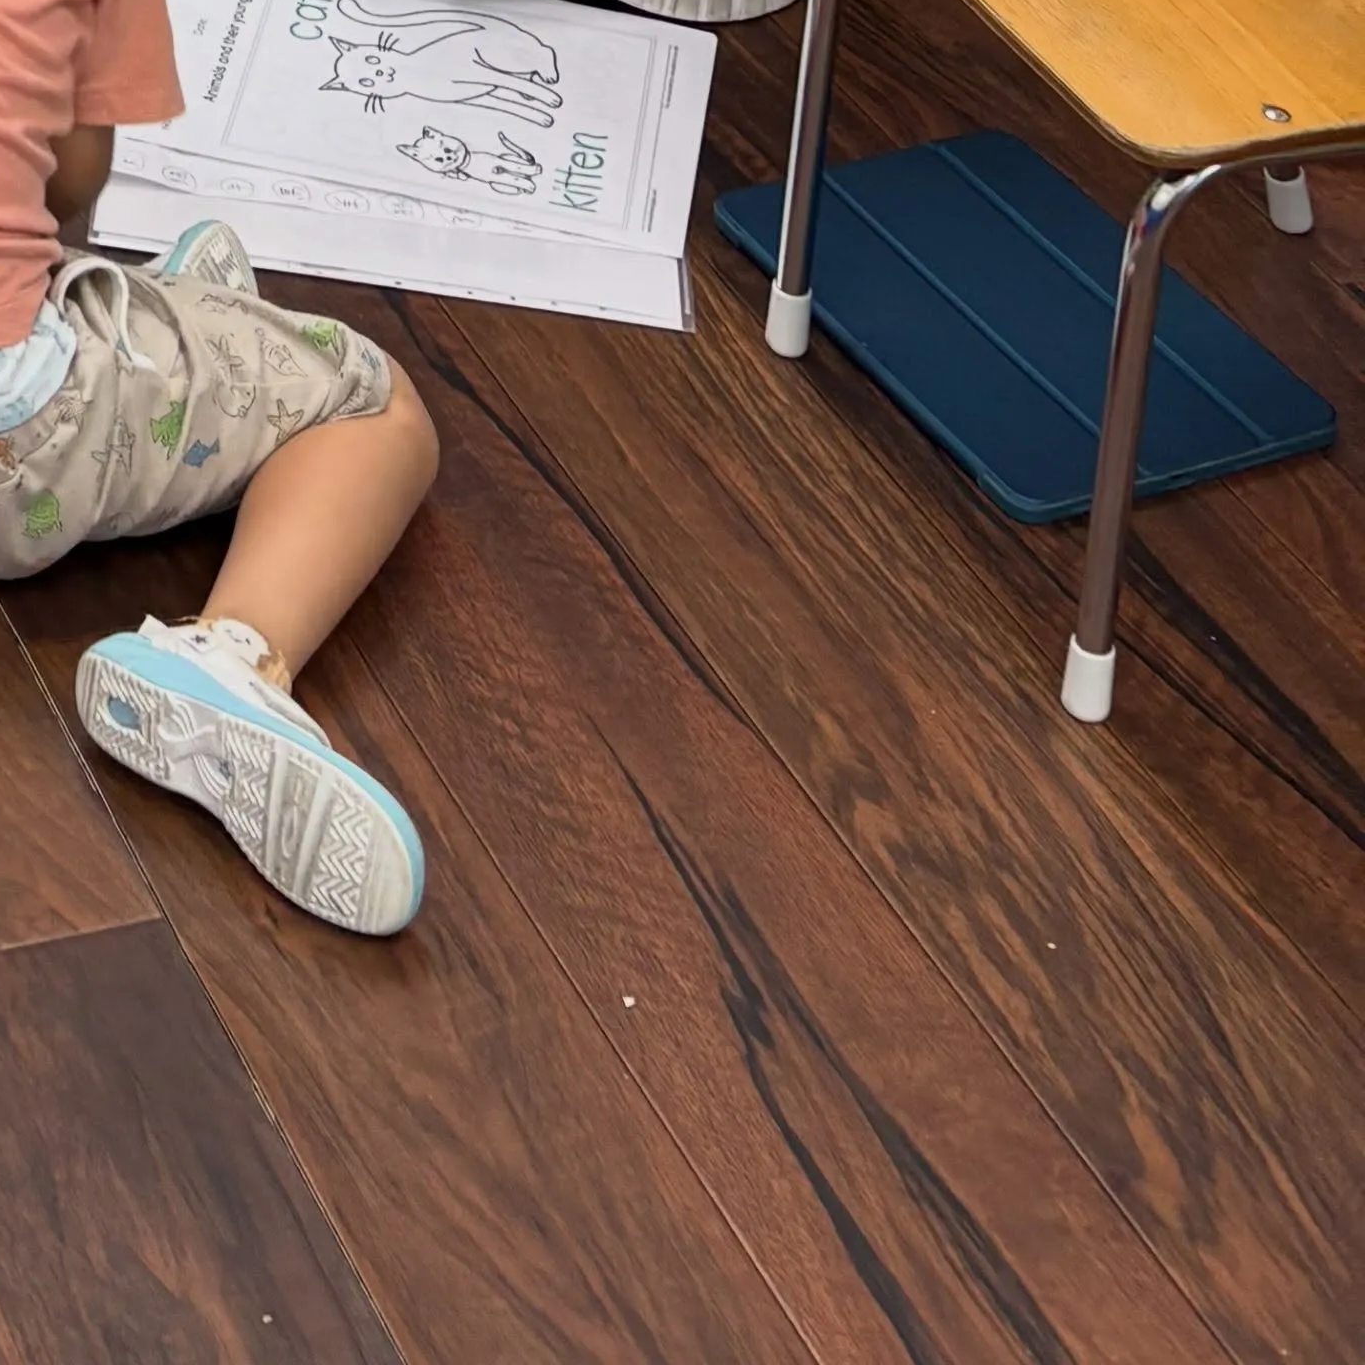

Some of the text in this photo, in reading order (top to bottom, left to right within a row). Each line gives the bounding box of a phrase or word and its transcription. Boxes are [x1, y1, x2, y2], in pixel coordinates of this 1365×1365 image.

[222, 23, 240, 45] their
[218, 45, 233, 65] and
[202, 65, 226, 103] Animals
[548, 131, 609, 213] kitten
